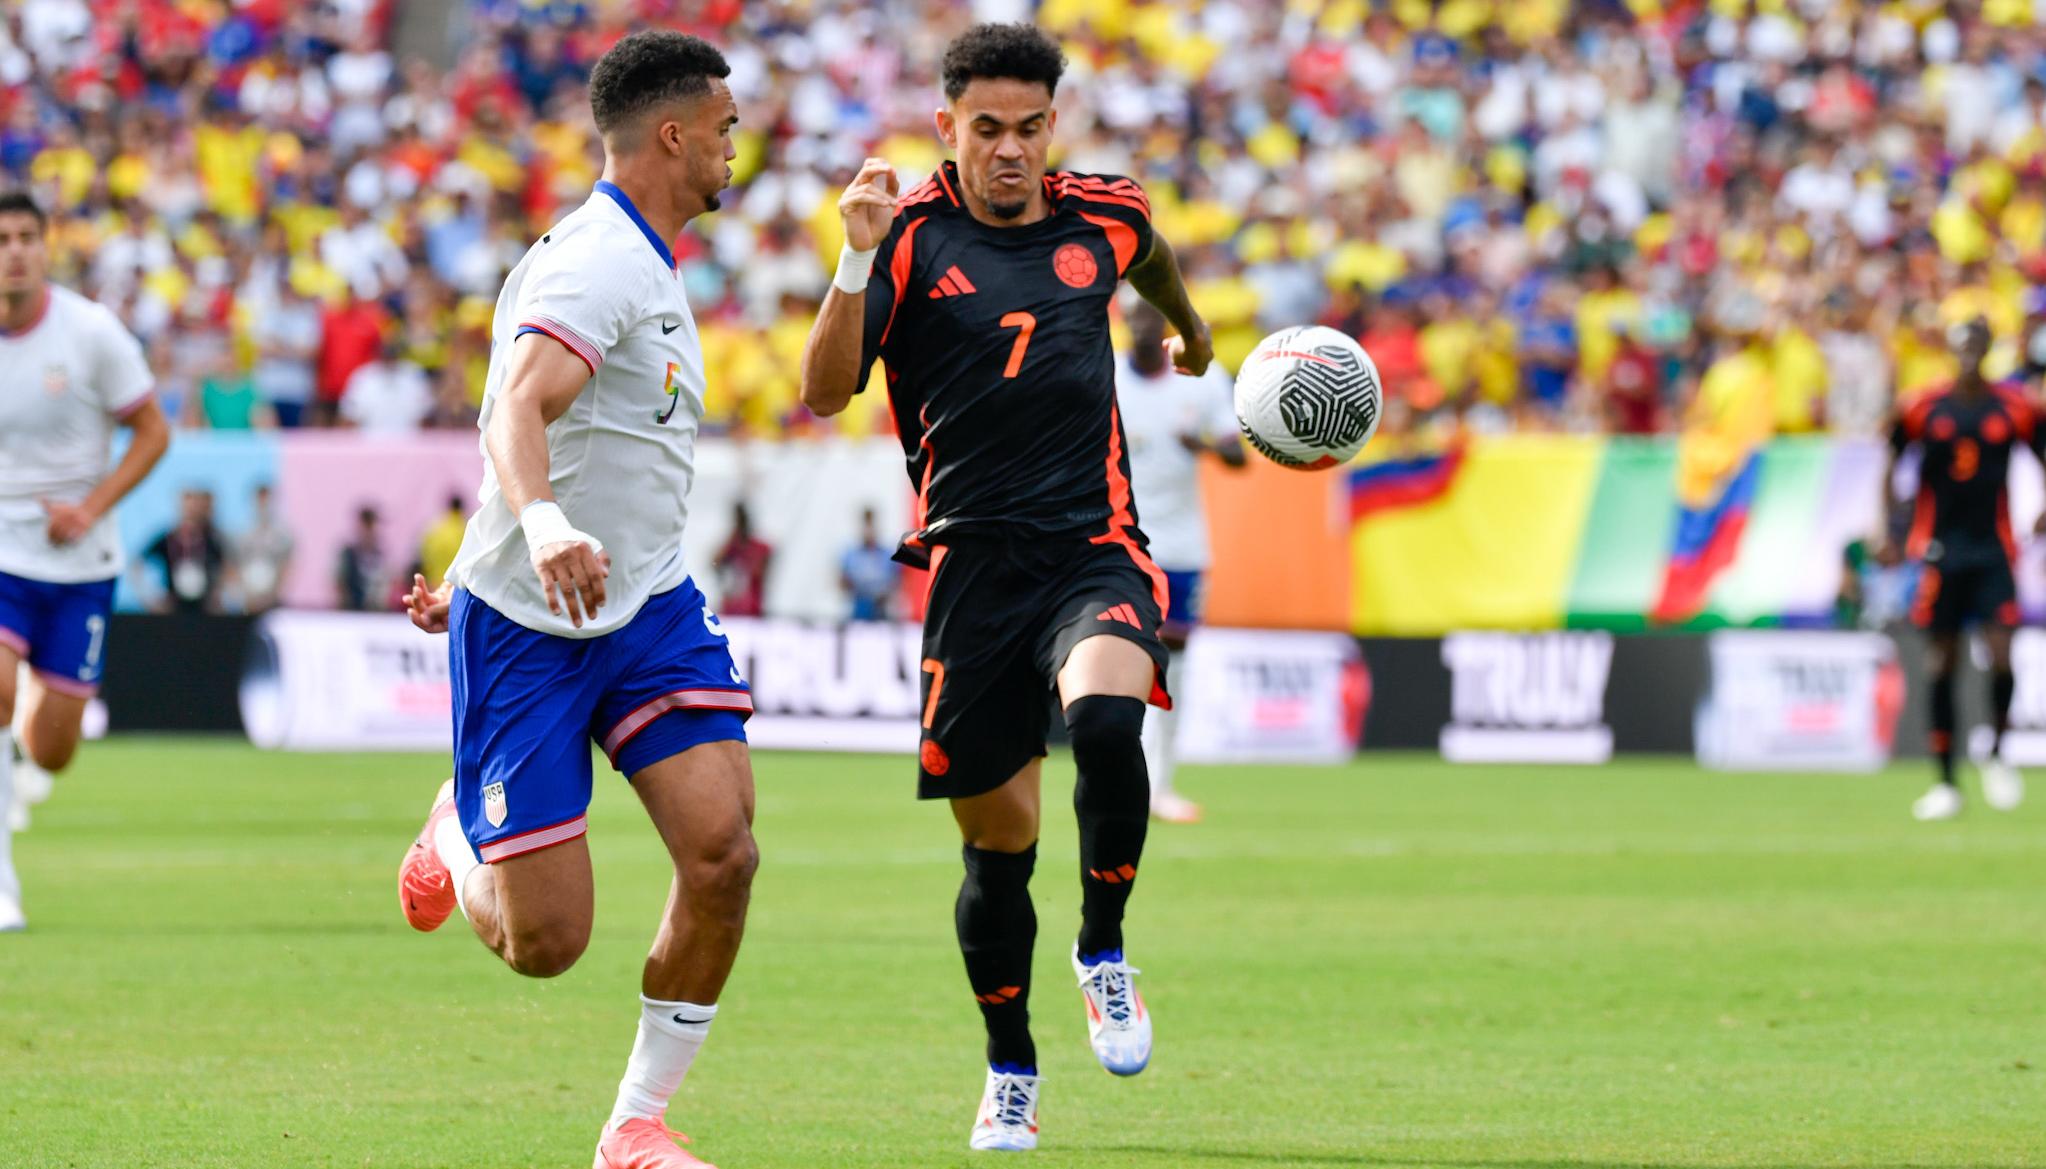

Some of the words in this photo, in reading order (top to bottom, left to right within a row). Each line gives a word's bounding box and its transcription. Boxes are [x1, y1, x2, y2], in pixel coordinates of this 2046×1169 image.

[1000, 311, 1037, 378] 7
[655, 361, 681, 425] 5
[922, 658, 944, 728] 7
[1440, 632, 1614, 724] TRULY
